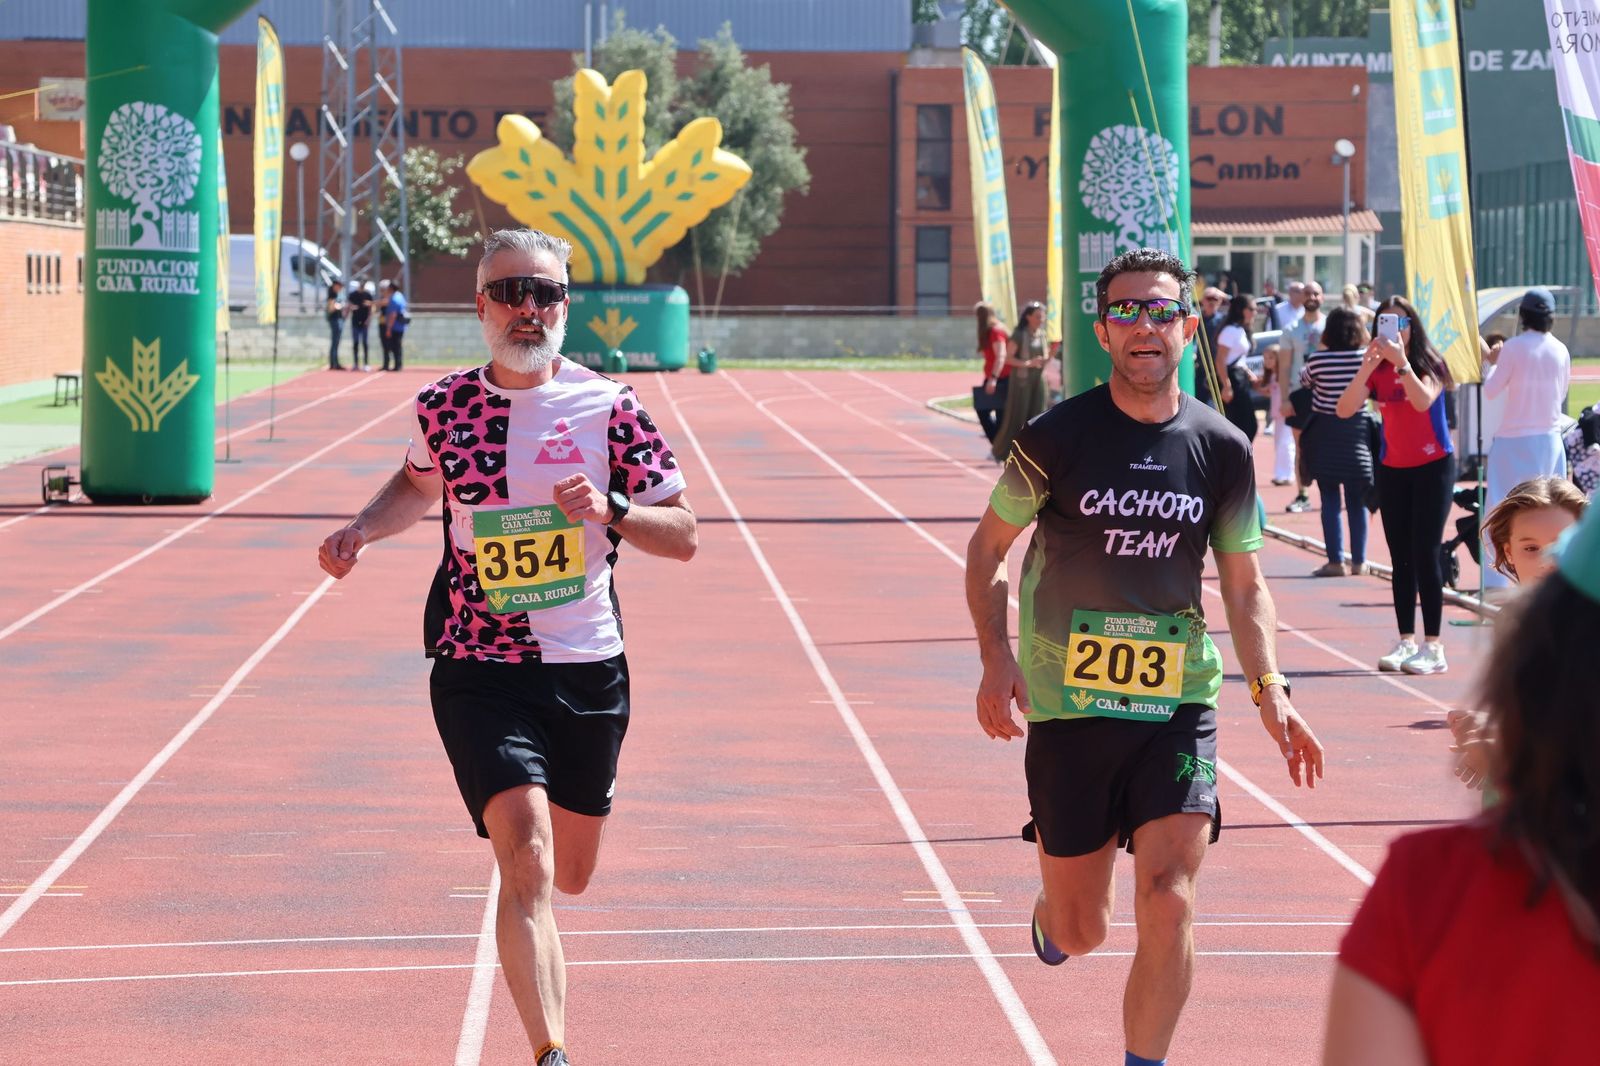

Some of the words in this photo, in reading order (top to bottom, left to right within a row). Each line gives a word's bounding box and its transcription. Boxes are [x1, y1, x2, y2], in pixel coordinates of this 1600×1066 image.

[1271, 51, 1393, 73] AYUNTAMI
[1468, 50, 1503, 71] DE
[96, 258, 199, 277] FUNDACION
[96, 275, 137, 292] CAJA
[140, 276, 200, 295] RURAL
[1129, 463, 1167, 471] TEAMERGY
[1080, 487, 1204, 524] CACHOPO
[502, 520, 522, 530] CAJA
[524, 517, 553, 527] RURAL
[1103, 529, 1180, 559] TEAM
[483, 534, 570, 581] 354
[512, 592, 542, 604] CAJA
[544, 585, 580, 600] RURAL
[1104, 624, 1125, 632] CAJA
[1127, 625, 1156, 635] RURAL
[1073, 639, 1167, 688] 203
[1096, 698, 1127, 712] CAJA
[1130, 702, 1173, 715] RURAL
